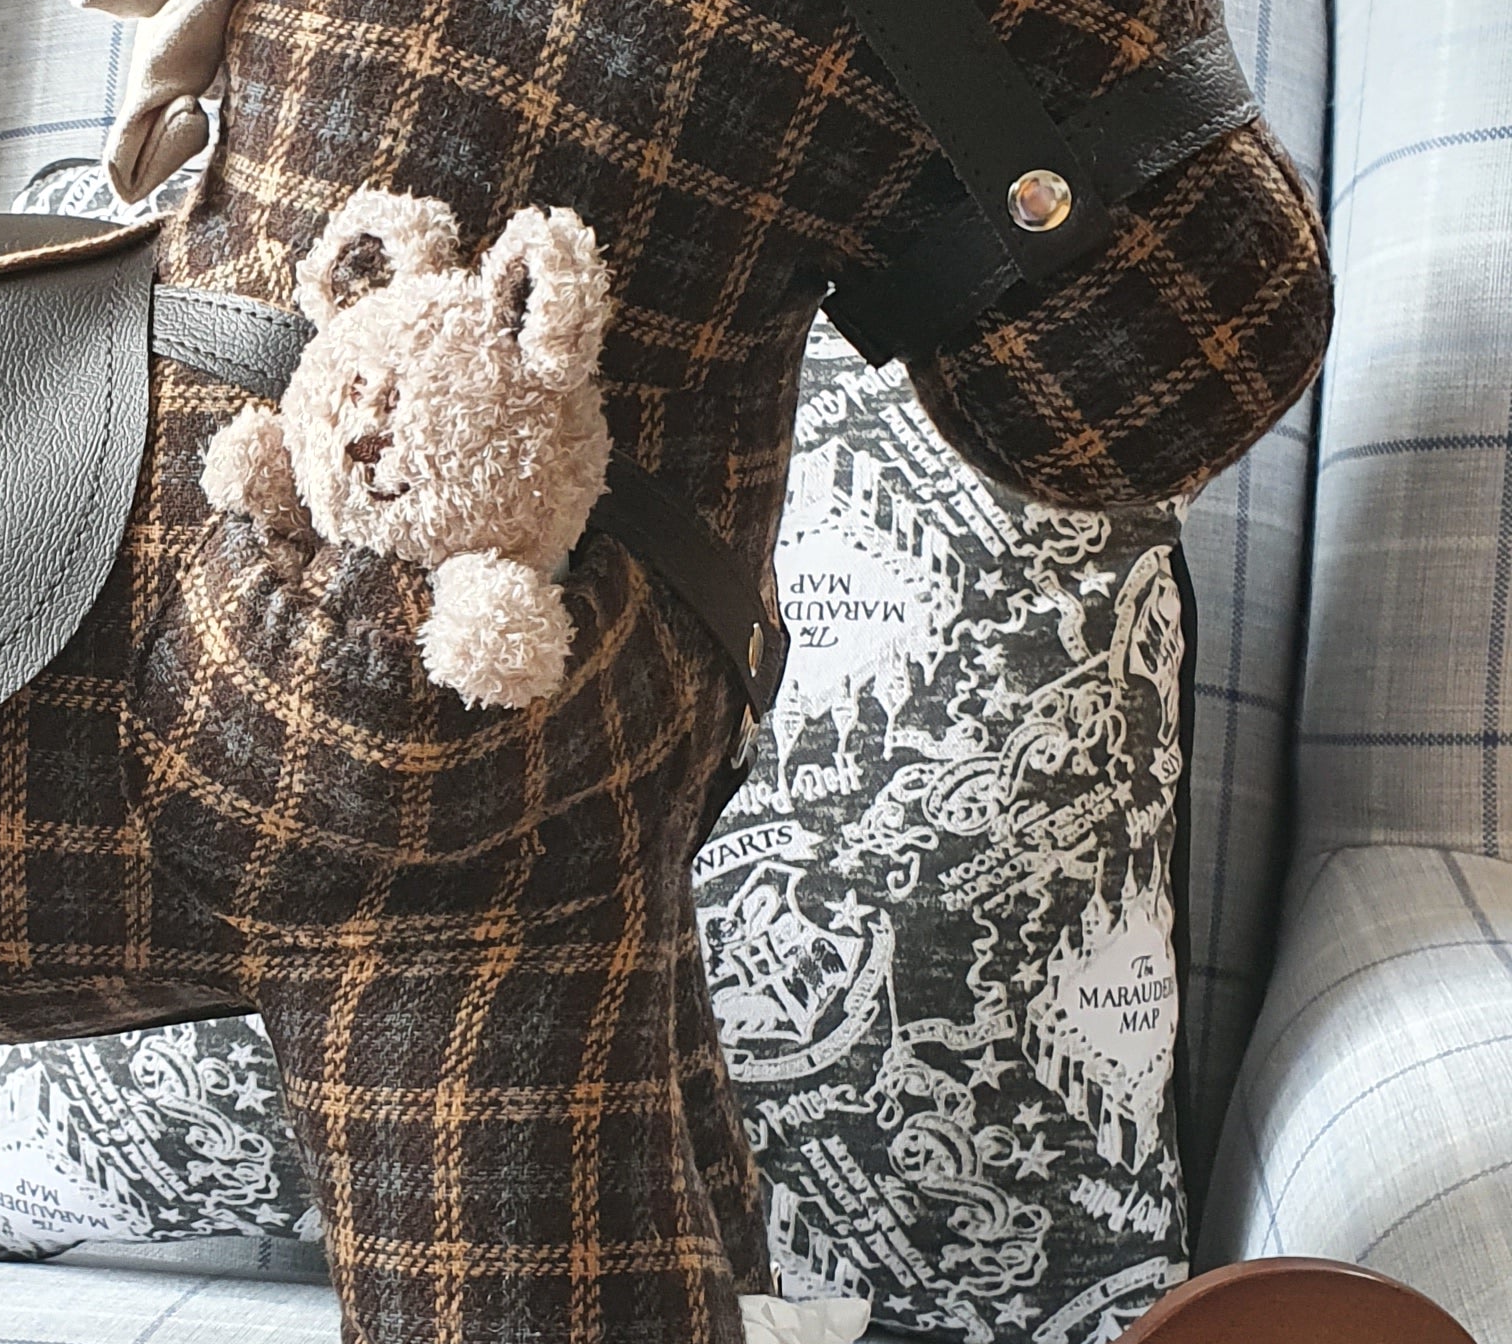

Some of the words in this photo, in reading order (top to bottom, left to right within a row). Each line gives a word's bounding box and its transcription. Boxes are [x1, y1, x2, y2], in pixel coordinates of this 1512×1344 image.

[789, 573, 851, 596] MAP
[779, 600, 906, 623] MARAUD
[799, 626, 839, 648] The
[1079, 976, 1174, 1009] MARAUDE
[1119, 1007, 1160, 1034] MAP
[16, 1178, 61, 1206] MAP
